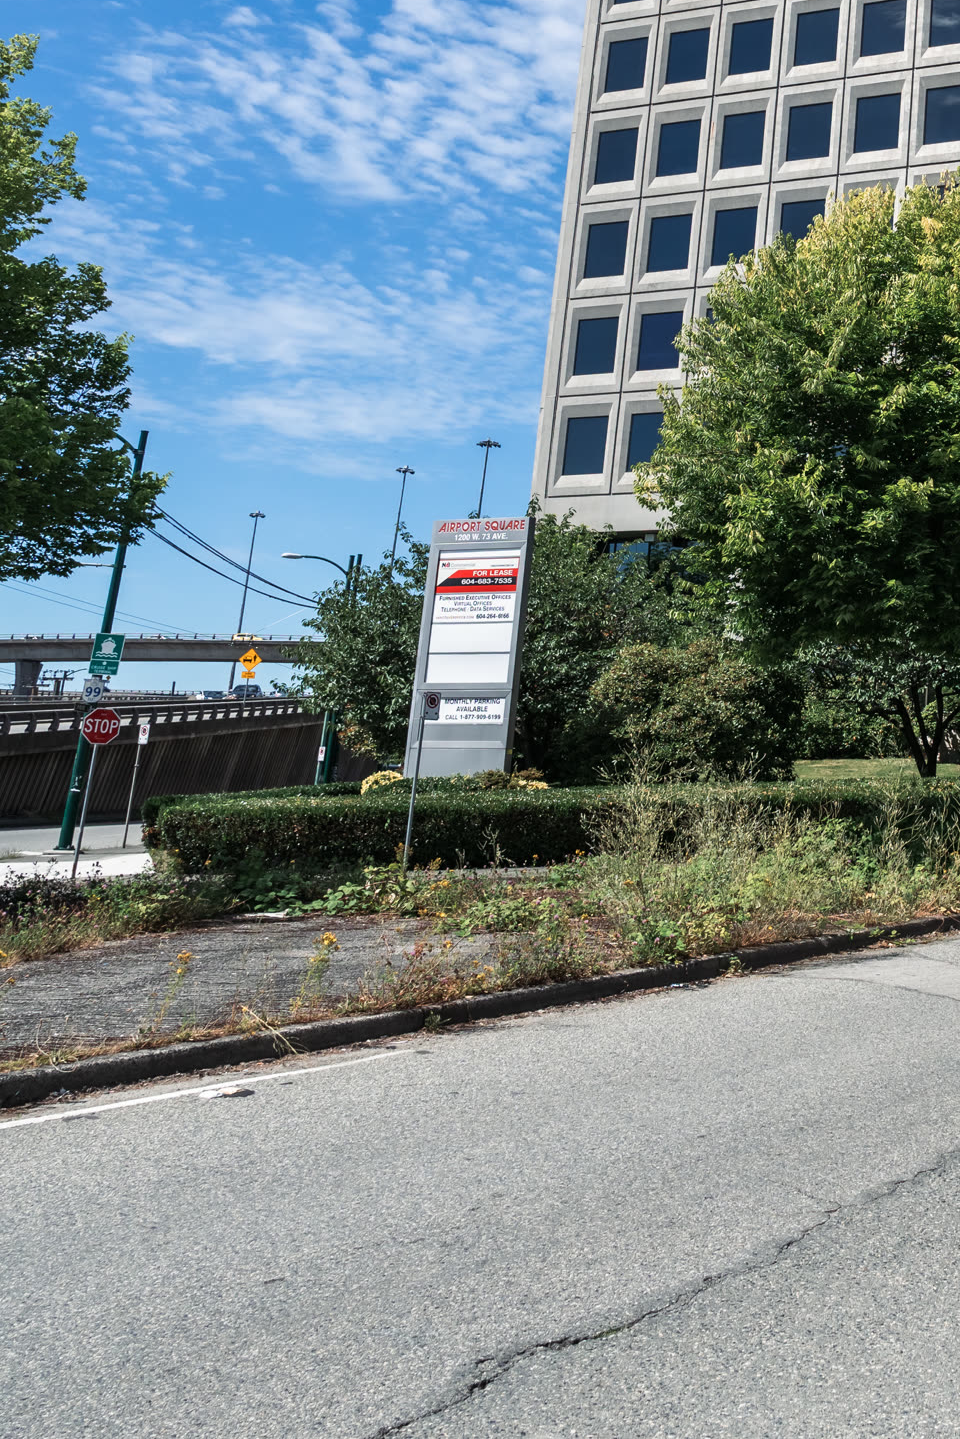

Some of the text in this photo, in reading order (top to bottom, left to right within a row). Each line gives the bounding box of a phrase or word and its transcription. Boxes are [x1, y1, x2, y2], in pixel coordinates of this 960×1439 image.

[438, 519, 526, 533] AIRPORT SQUARE
[492, 532, 508, 540] AVE.
[461, 577, 513, 585] 604-683-7535
[85, 686, 101, 697] 99
[84, 718, 119, 734] STOP
